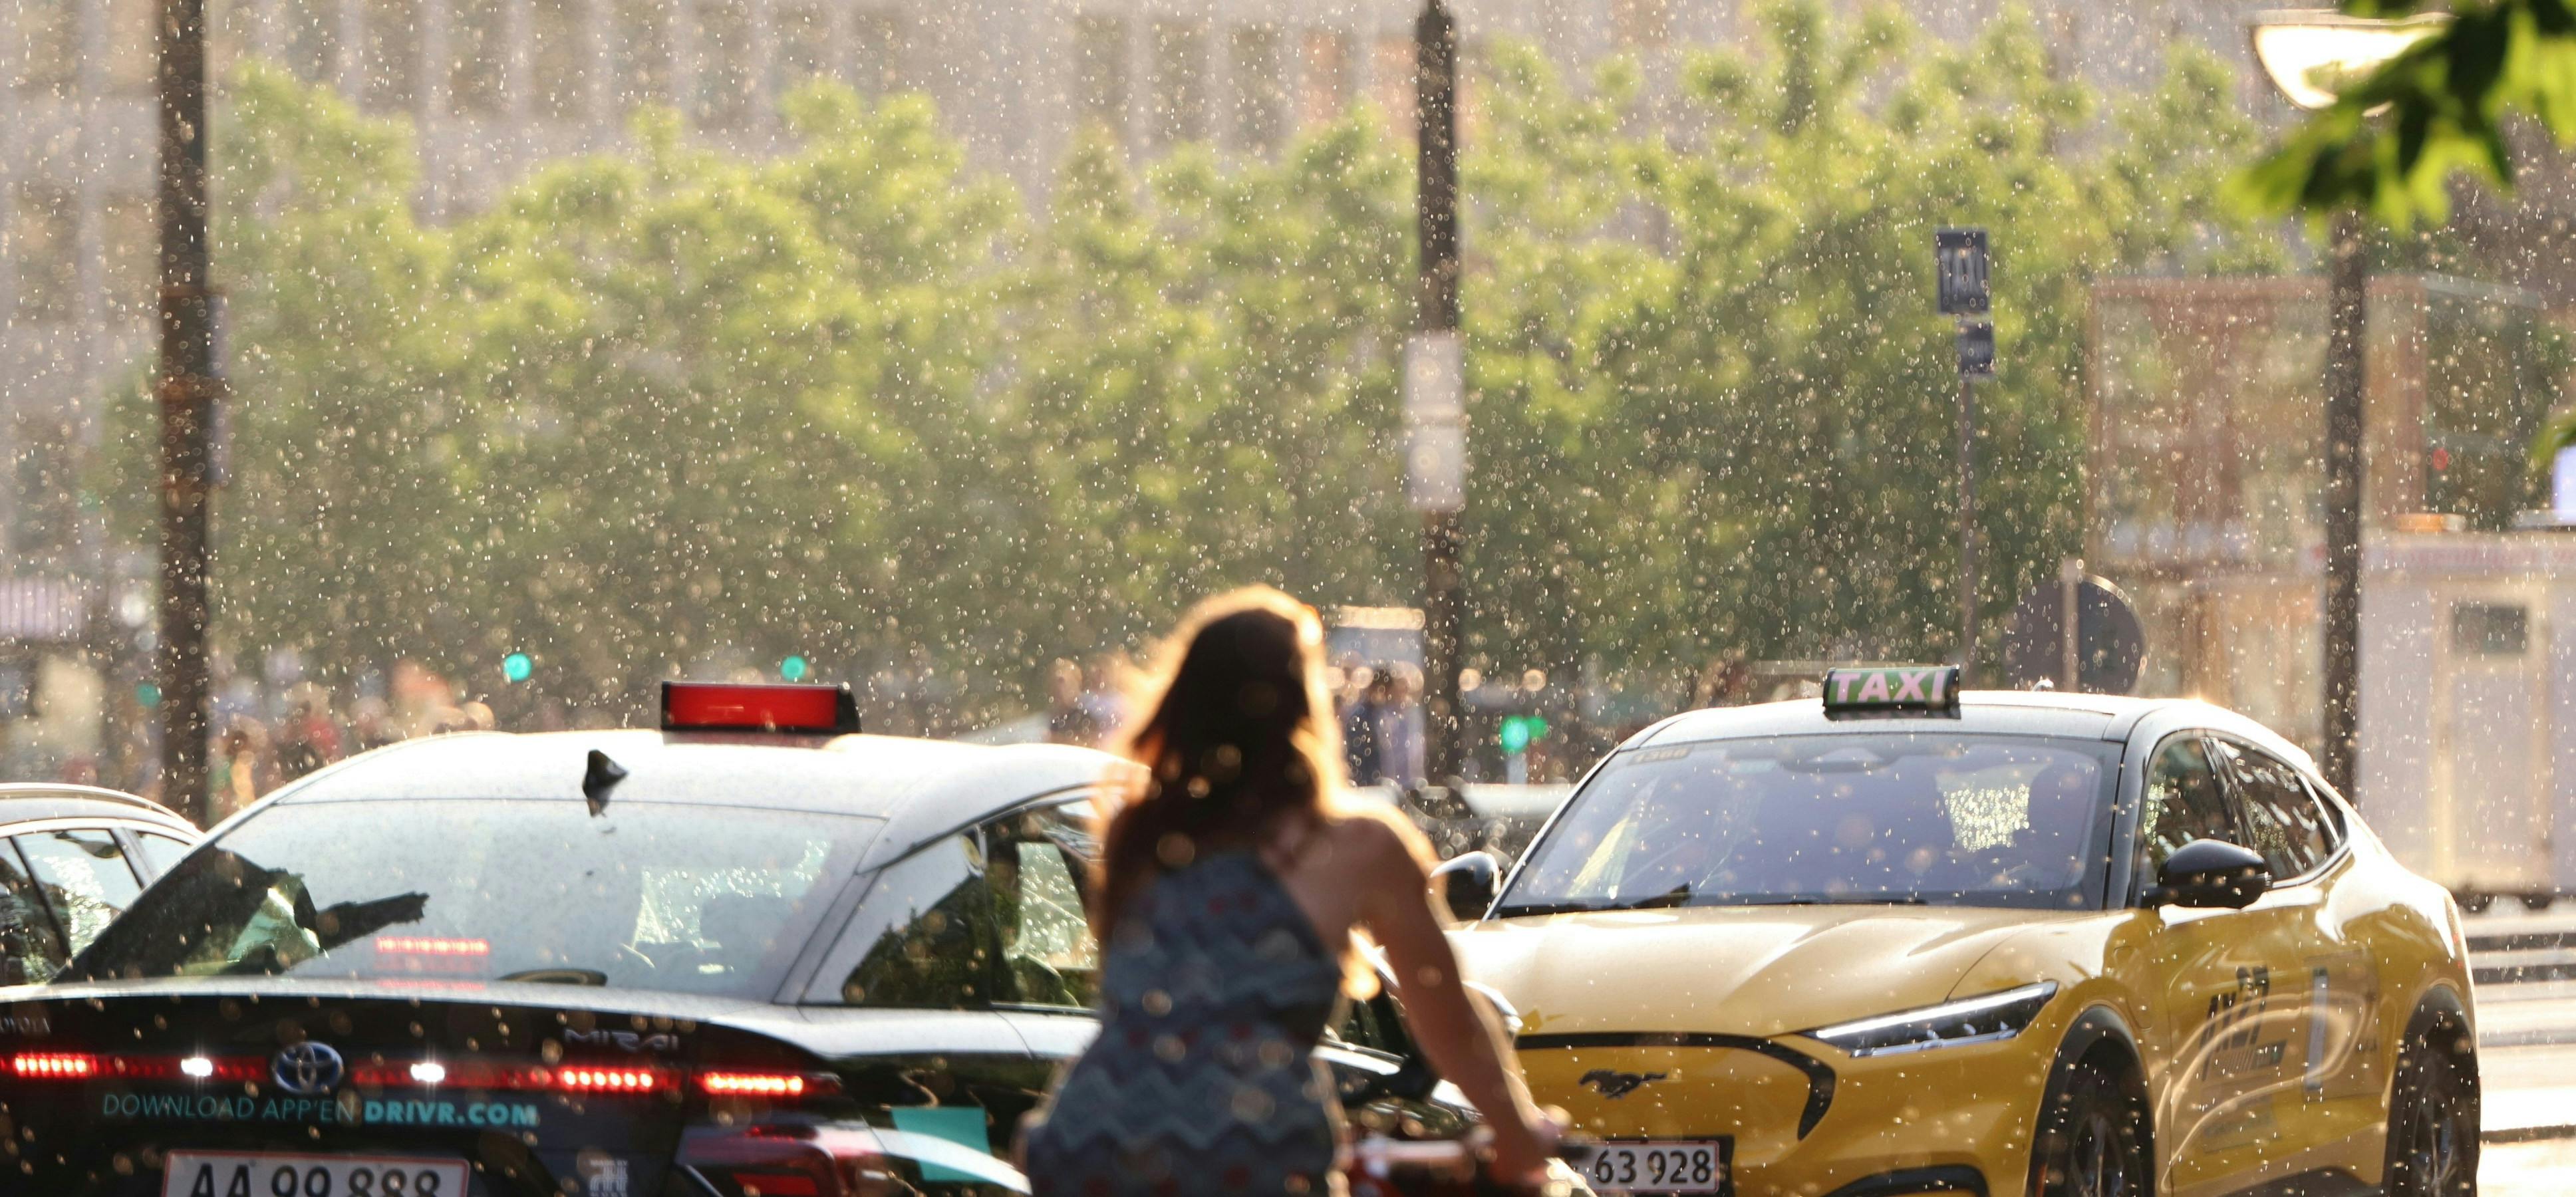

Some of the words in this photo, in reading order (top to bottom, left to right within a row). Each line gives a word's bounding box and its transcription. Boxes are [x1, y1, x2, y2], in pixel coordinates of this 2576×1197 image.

[1830, 670, 1947, 704] TAXI
[565, 1029, 678, 1051] MIRAI
[102, 1094, 254, 1119] DOWNLOAD
[262, 1098, 355, 1122] APP'EN
[365, 1100, 538, 1127] DRIVR.COM
[191, 1163, 251, 1197] AA
[1596, 1149, 1637, 1184] 63
[1647, 1149, 1712, 1184] 928
